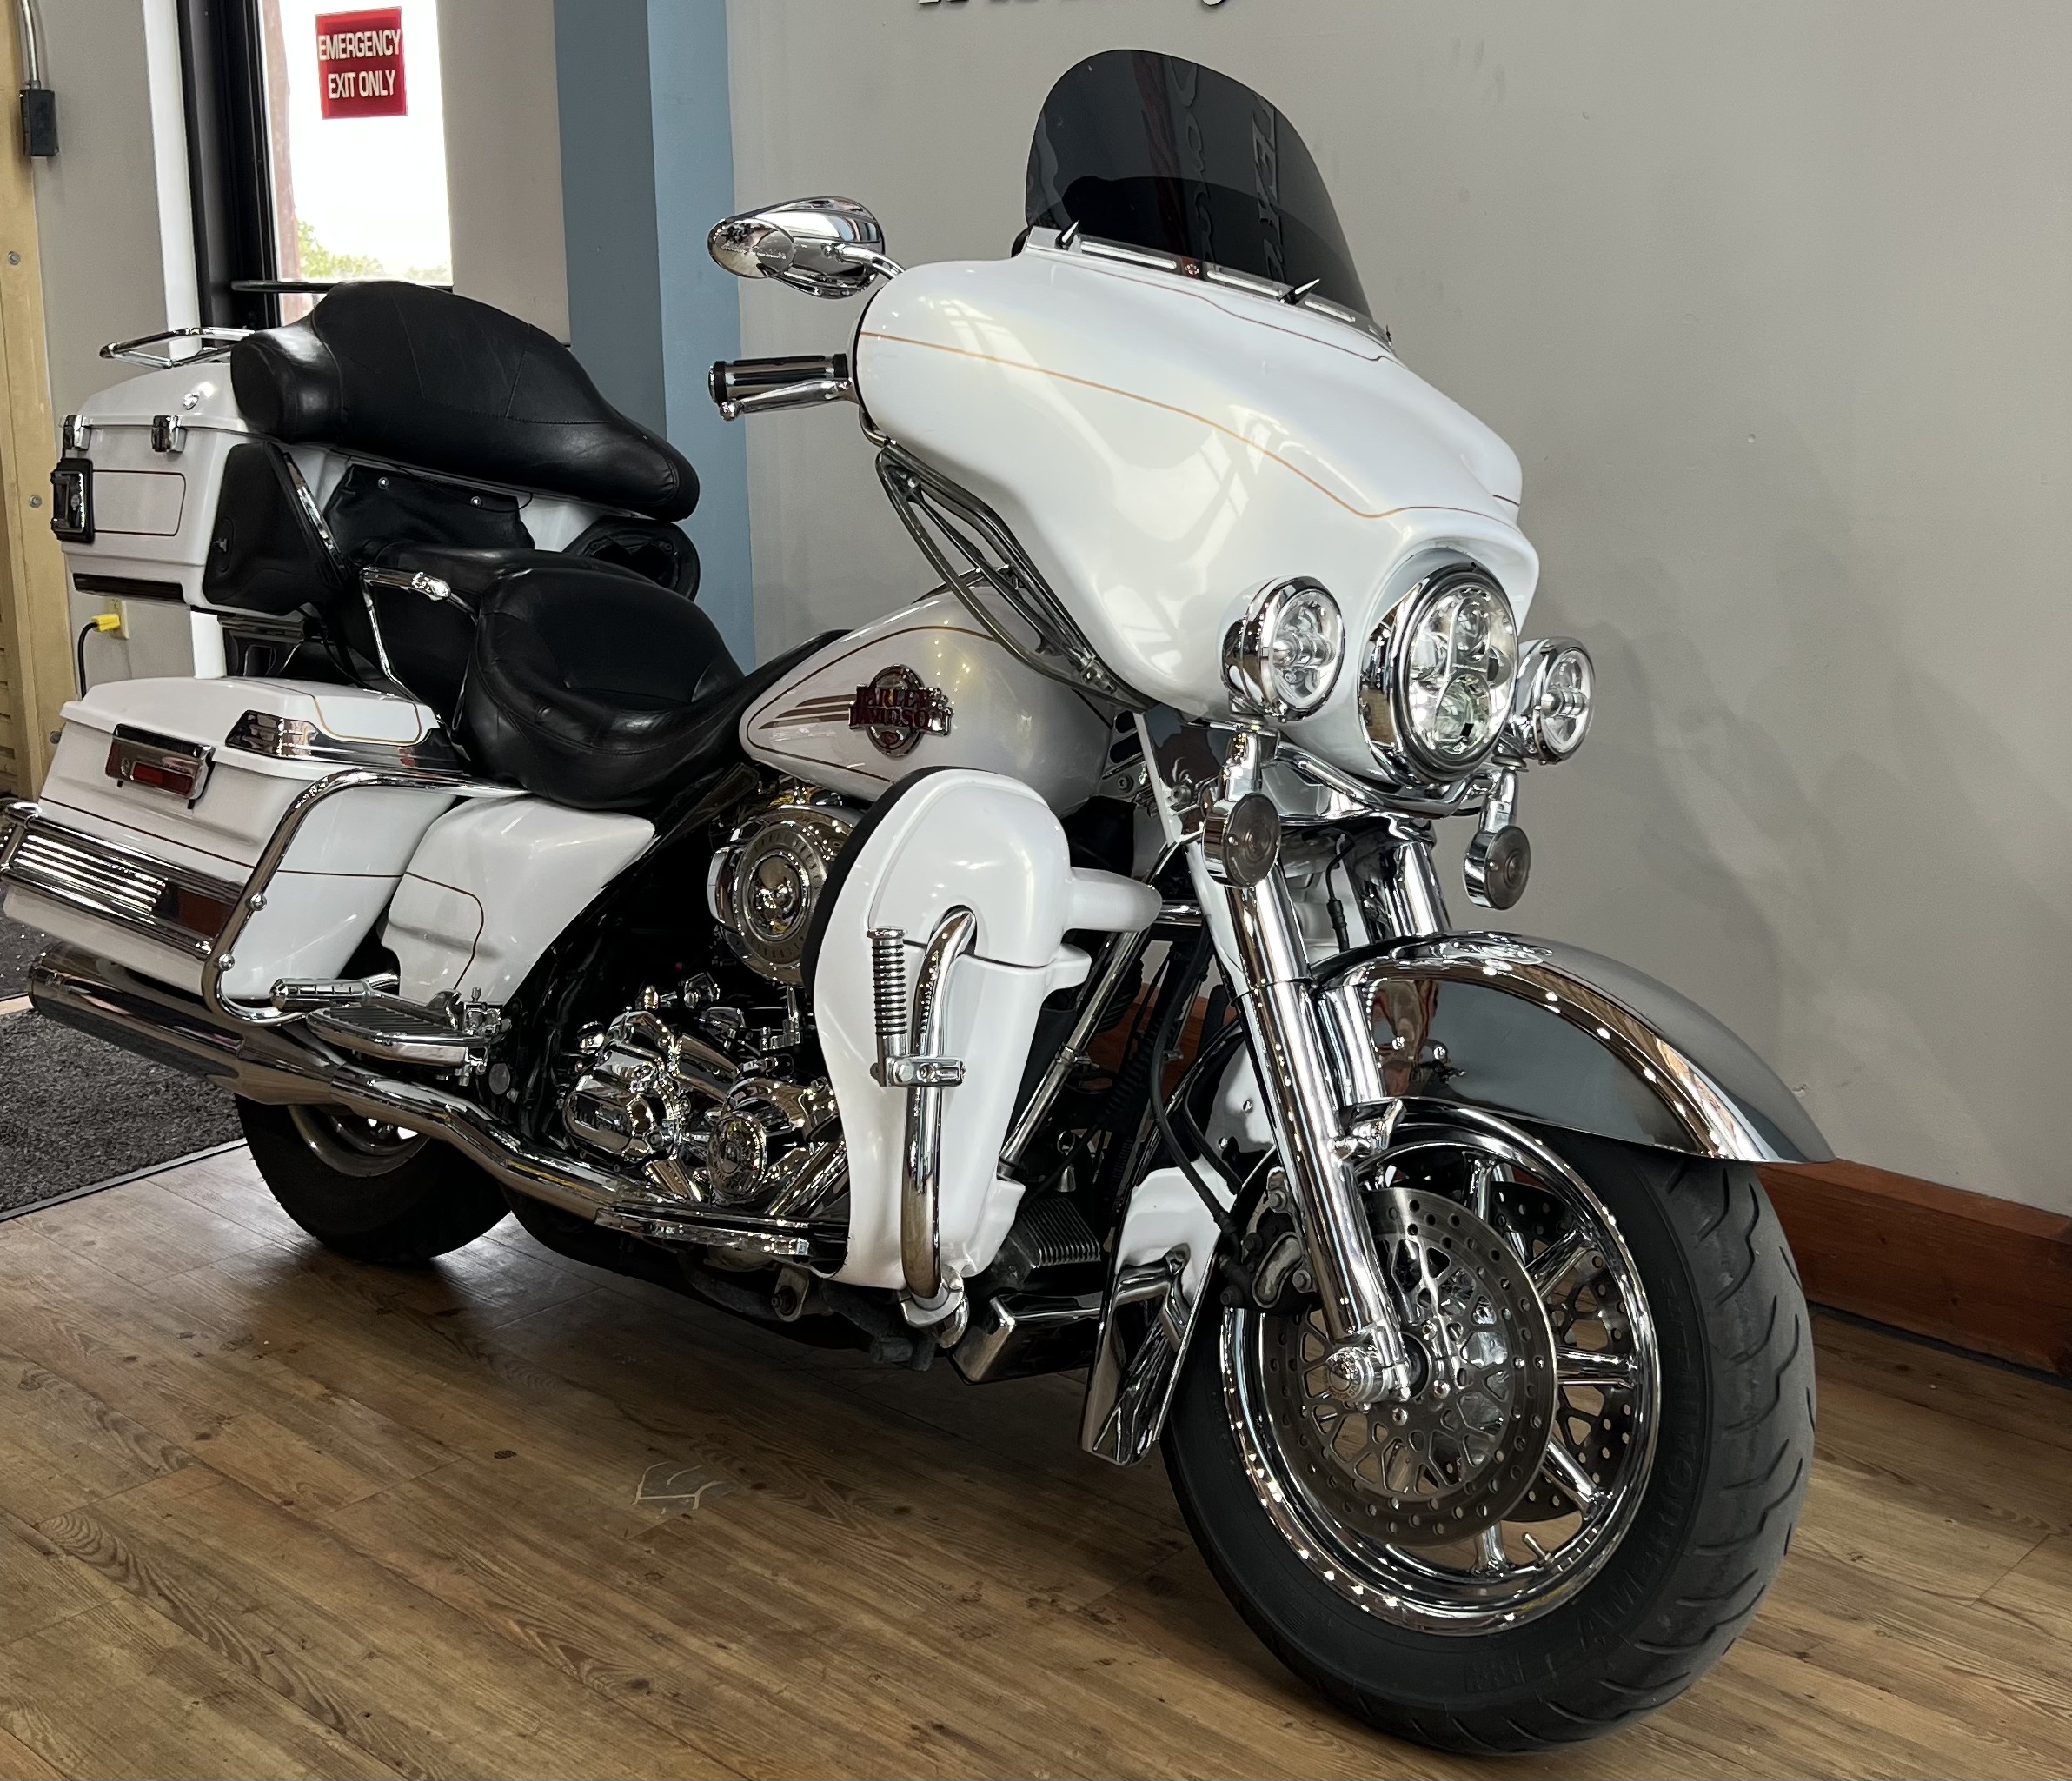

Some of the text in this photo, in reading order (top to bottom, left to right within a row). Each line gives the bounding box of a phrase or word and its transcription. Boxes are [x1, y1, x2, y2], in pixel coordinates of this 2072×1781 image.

[317, 28, 402, 62] EMERGENCY
[327, 69, 396, 100] EXIT ONLY
